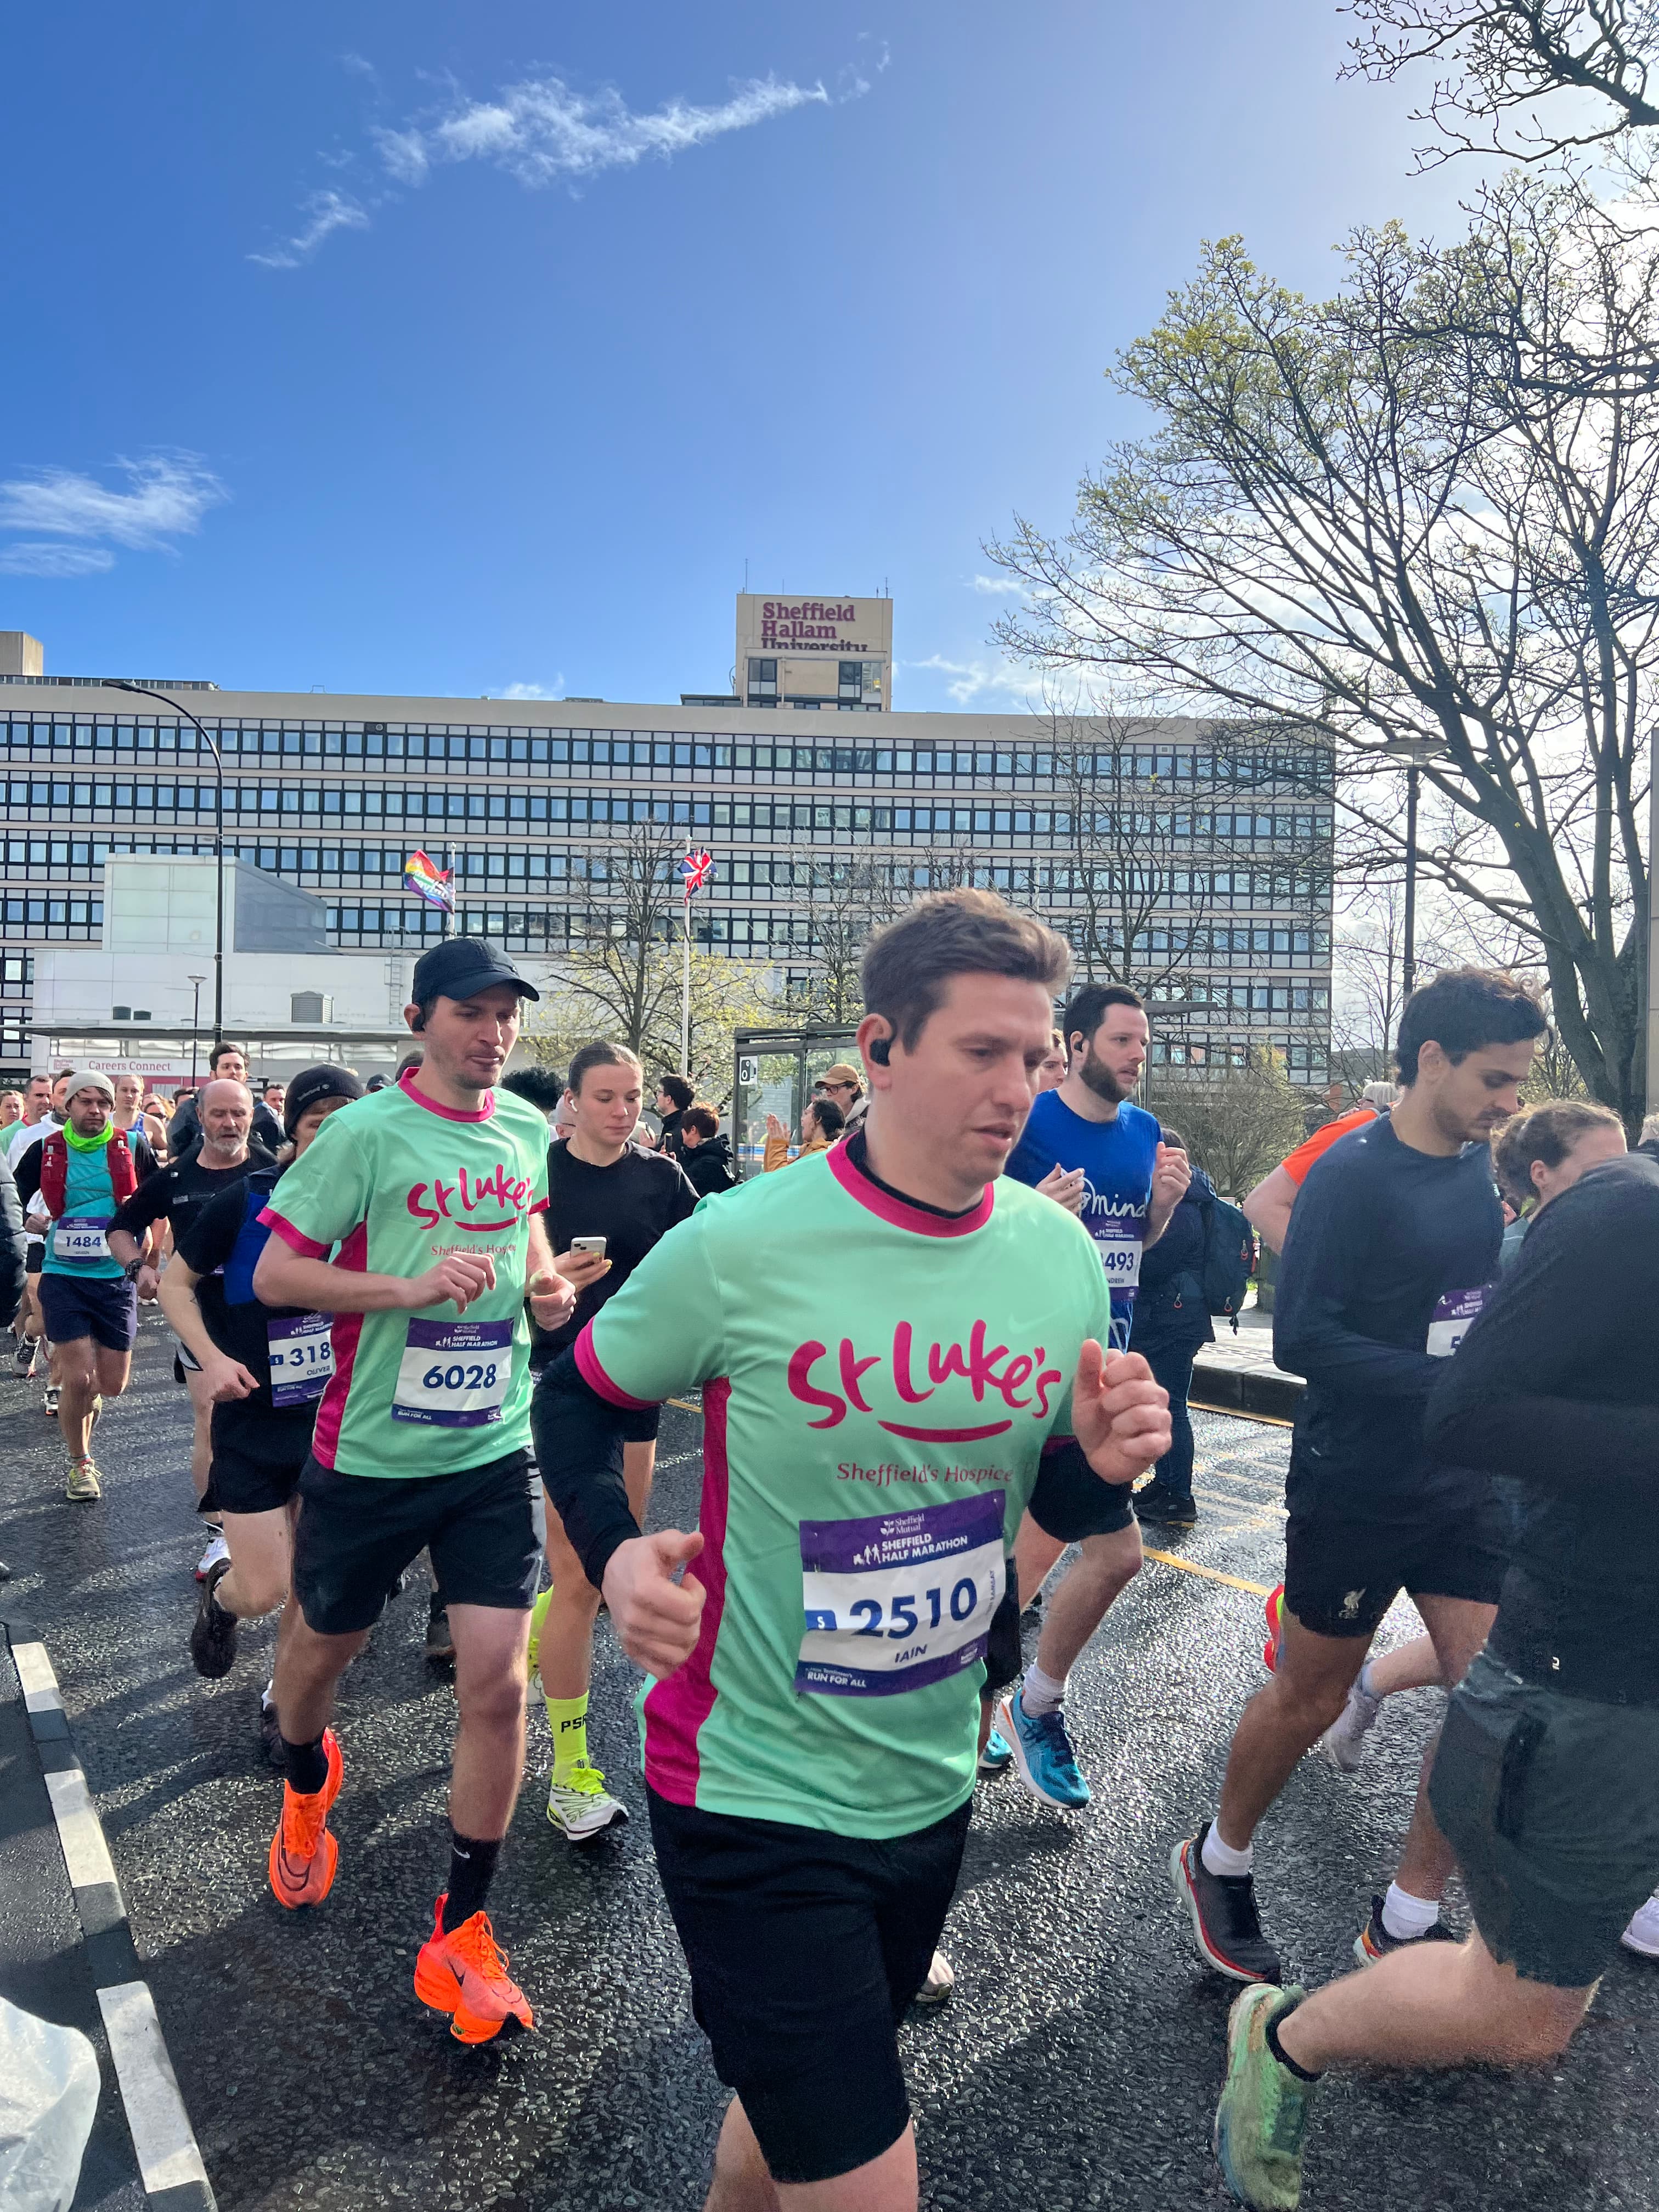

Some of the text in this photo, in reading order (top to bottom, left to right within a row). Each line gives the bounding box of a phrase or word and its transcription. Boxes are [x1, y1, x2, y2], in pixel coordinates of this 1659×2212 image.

[763, 602, 856, 622] Sheffield
[761, 620, 837, 639] Hallam
[88, 1060, 127, 1070] Careers
[129, 1061, 171, 1071] Connect
[66, 1236, 101, 1248] 1484
[1101, 1251, 1134, 1271] 493
[290, 1342, 331, 1367] 318
[423, 1363, 497, 1390] 6028
[837, 1463, 1014, 1488] Sheffield's Hospice
[895, 1513, 925, 1526] Sheffield
[896, 1522, 921, 1535] Mutual
[882, 1533, 932, 1551] SHEFFIELD
[882, 1536, 968, 1562] HALF MARATHON
[817, 1577, 977, 1639] S 2510
[895, 1644, 928, 1663] IAIN
[808, 1672, 867, 1688] RUN FOR ALL
